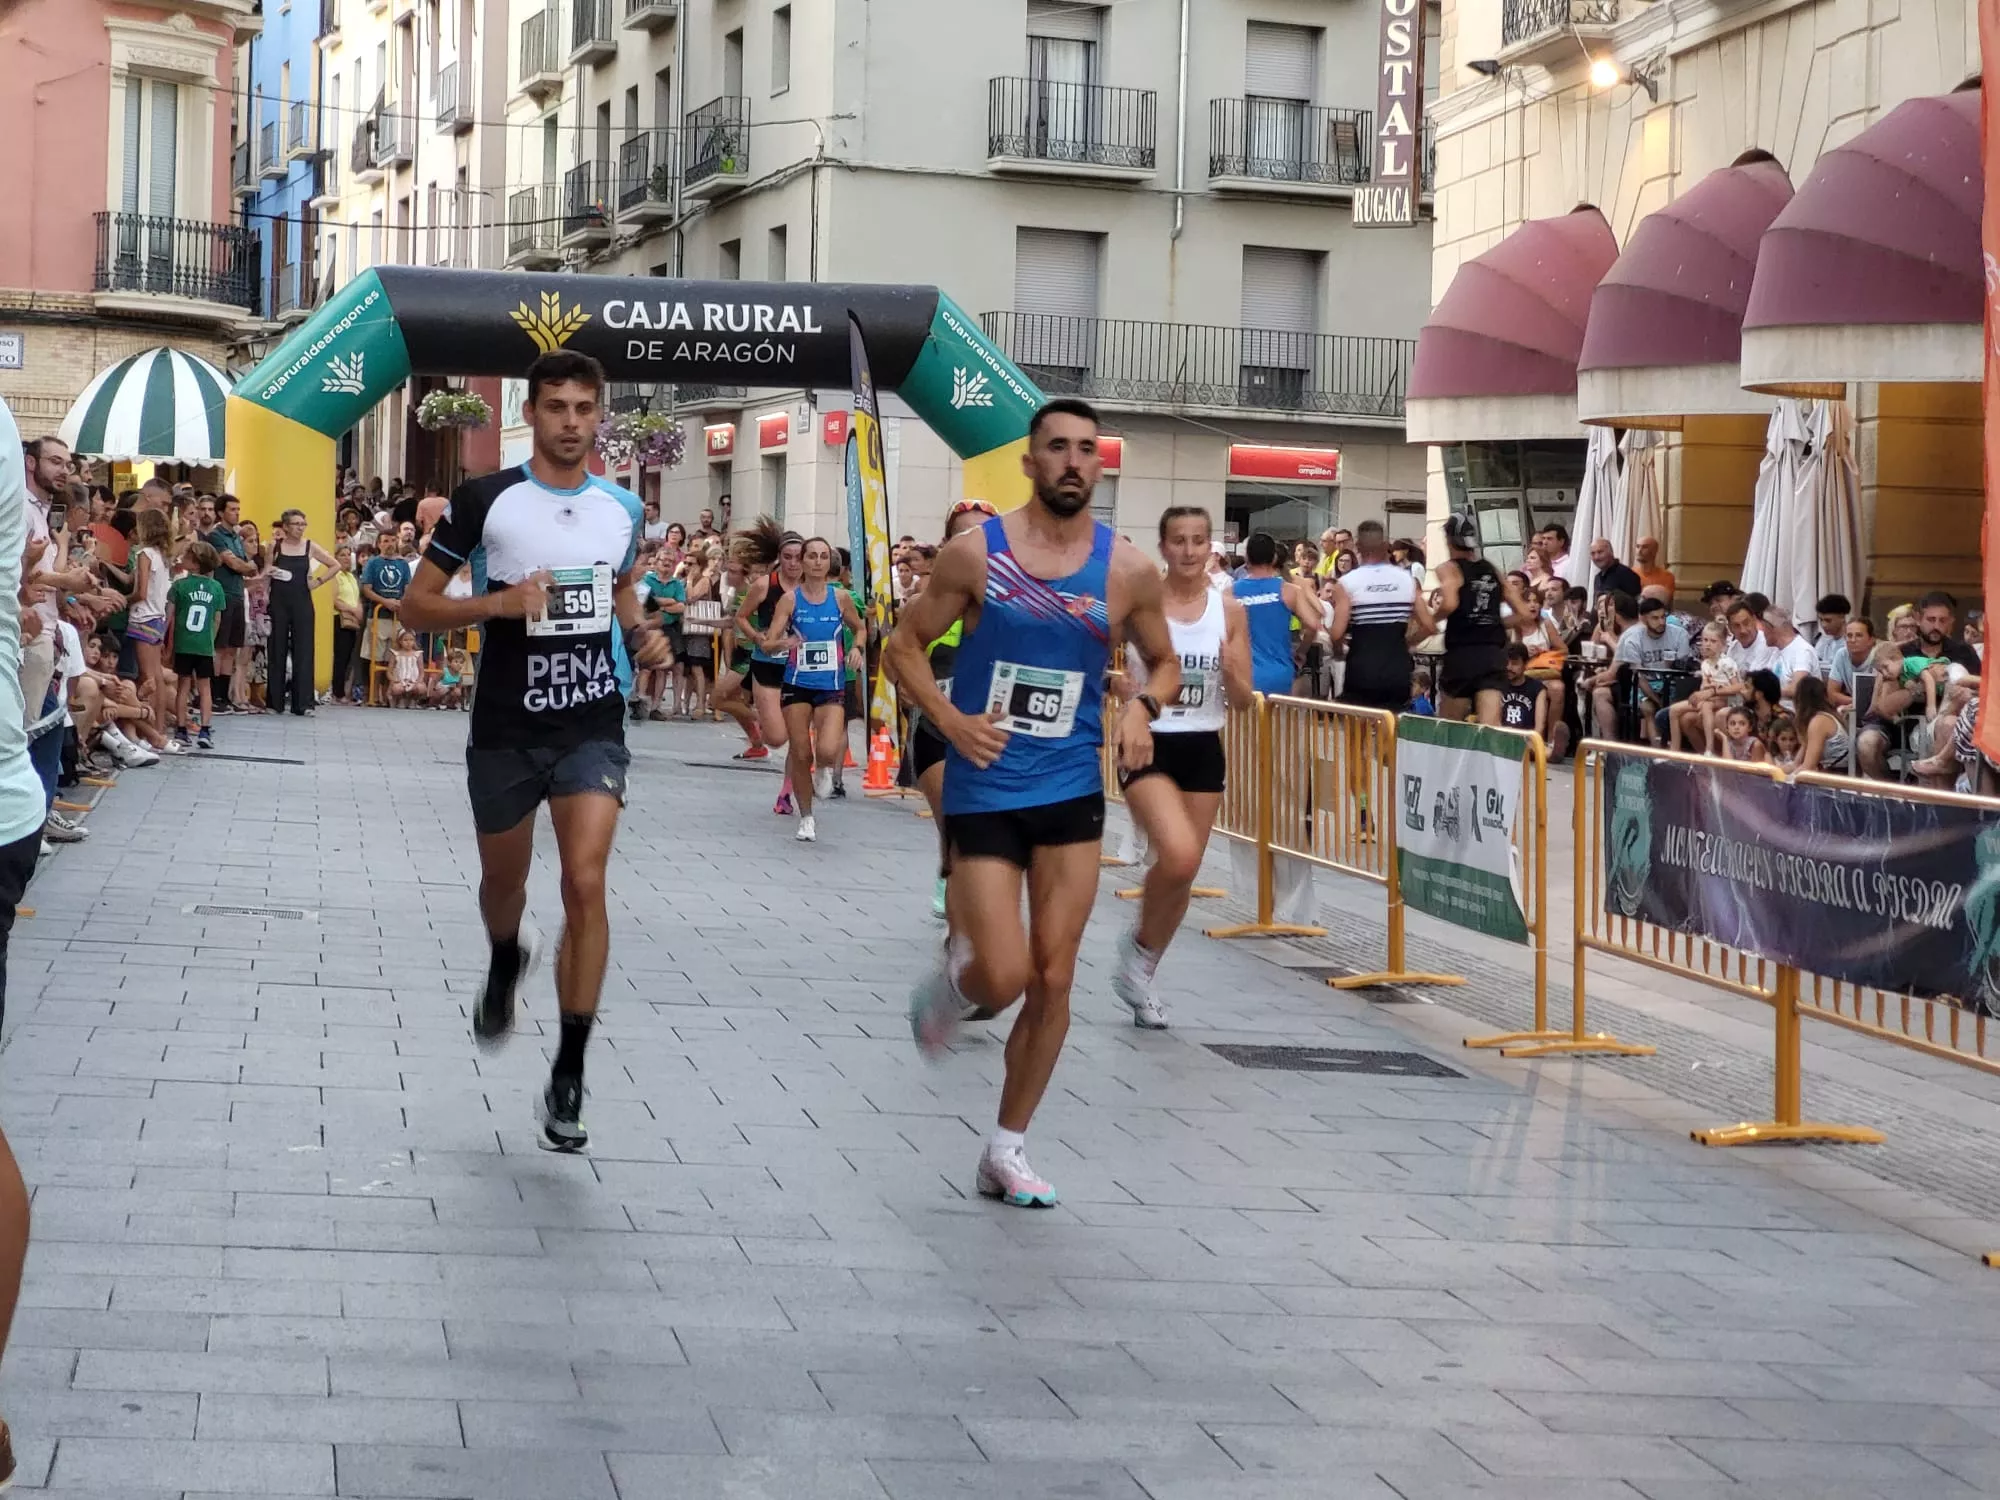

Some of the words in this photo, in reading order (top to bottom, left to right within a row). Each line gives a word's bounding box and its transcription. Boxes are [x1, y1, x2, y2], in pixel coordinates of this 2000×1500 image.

[1353, 187, 1411, 223] RUGACA
[602, 300, 694, 331] CAJA
[703, 302, 823, 334] RURAL
[261, 289, 380, 400] cajaruraldearagon.es
[626, 340, 665, 360] DE
[672, 338, 796, 364] ARAGÓN
[188, 590, 214, 604] TATUM
[564, 589, 593, 614] 59
[186, 605, 208, 632] 0
[527, 643, 610, 687] PEÑA
[1176, 654, 1220, 672] BES
[523, 679, 616, 712] GUARA
[1027, 691, 1060, 718] 66
[1775, 852, 1851, 909] PIEDRA
[1852, 868, 1871, 913] A
[1872, 871, 1962, 931] PIEDRA
